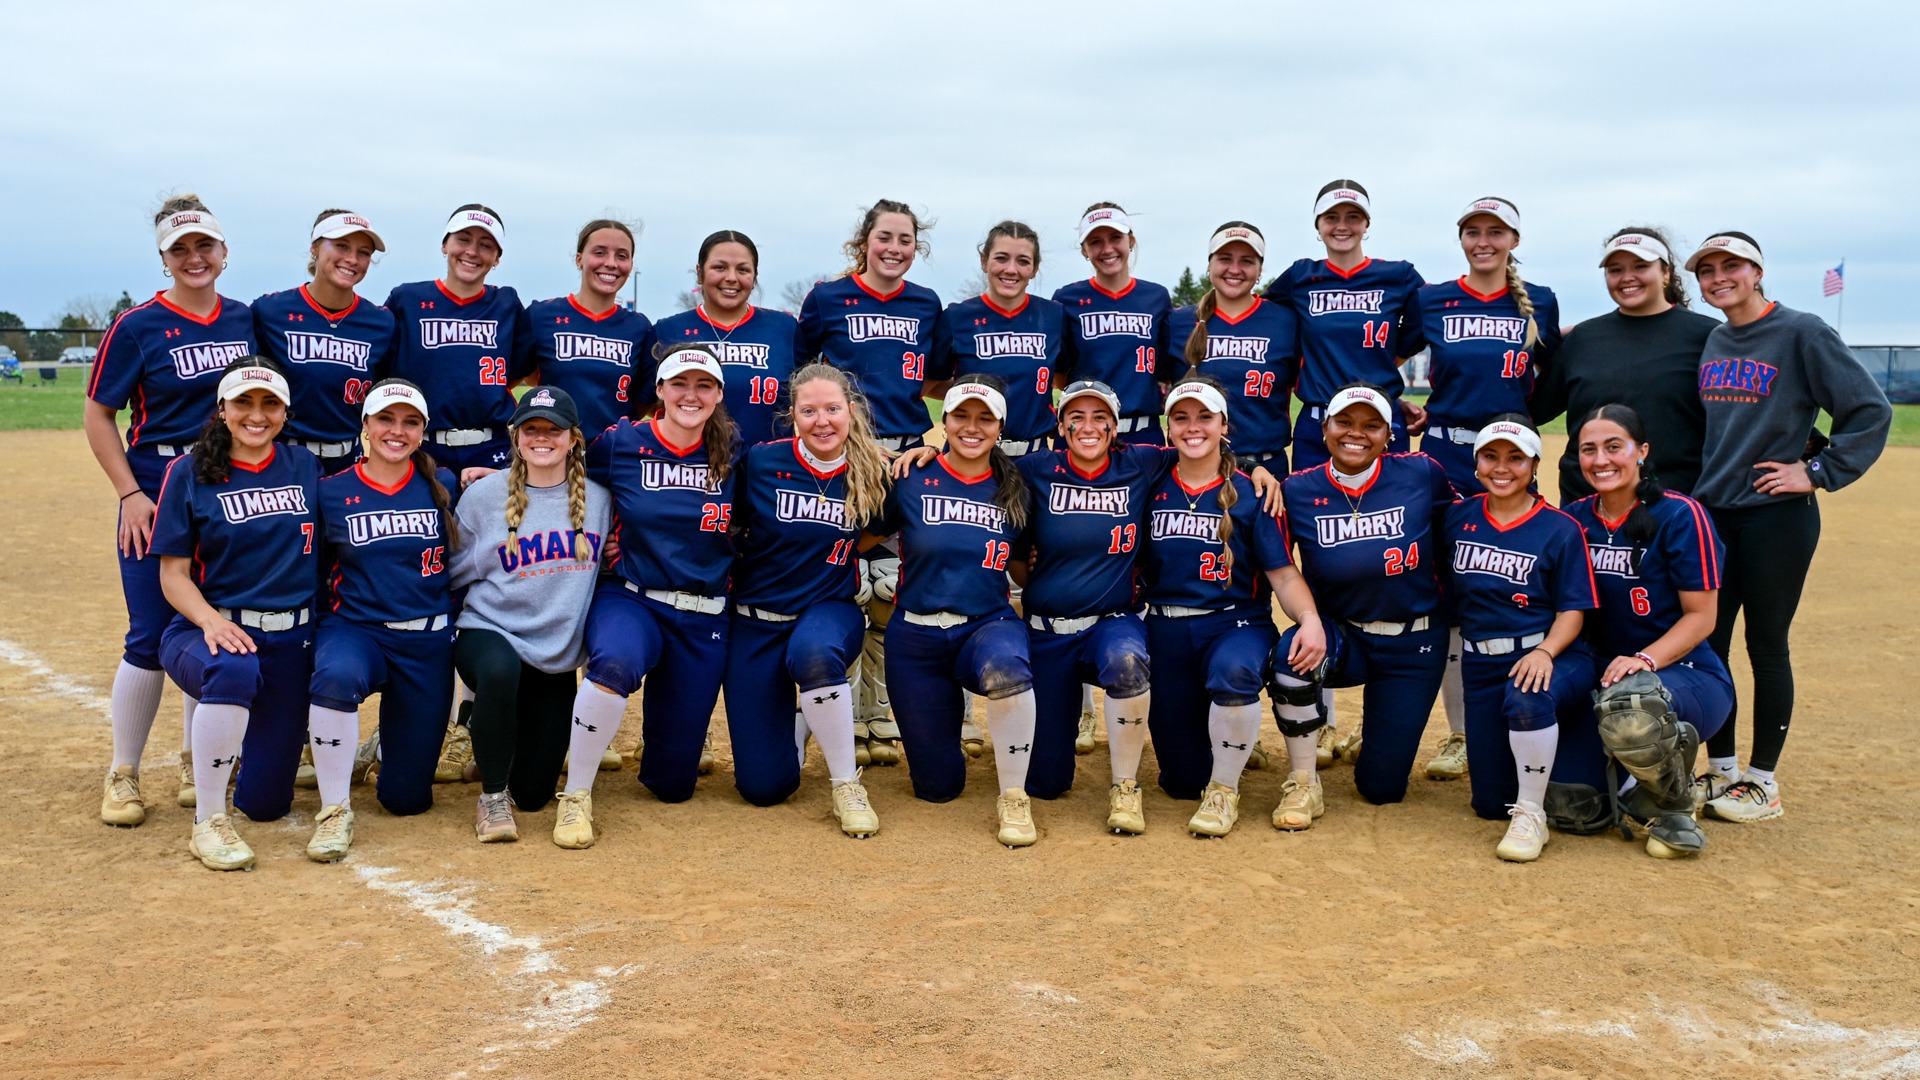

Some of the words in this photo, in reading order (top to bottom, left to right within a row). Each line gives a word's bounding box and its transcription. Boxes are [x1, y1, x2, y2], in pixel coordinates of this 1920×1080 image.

[1334, 191, 1358, 201] UMARY
[1473, 201, 1500, 211] UMARY
[171, 214, 201, 227] UMARY
[343, 216, 370, 229] UMARY
[467, 212, 494, 226] UMARY
[1088, 210, 1112, 223] UMARY
[1225, 230, 1250, 239] UMARY
[1615, 236, 1642, 246] UMARY
[1311, 291, 1383, 315] UMARY
[421, 319, 497, 348] UMARY
[847, 315, 919, 343] UMARY
[1080, 312, 1152, 338] UMARY
[1362, 320, 1389, 348] 14
[1444, 316, 1525, 342] UMARY
[286, 332, 370, 370] UMARY
[556, 333, 631, 366] UMARY
[706, 343, 767, 367] MARY
[975, 332, 1046, 358] UMARY
[479, 356, 506, 385] 22
[679, 353, 708, 366] UMARY
[902, 352, 924, 381] 21
[1135, 346, 1156, 373] 19
[1501, 350, 1529, 378] 16
[242, 369, 272, 382] UMARY
[616, 374, 631, 402] 9
[1036, 367, 1050, 394] 8
[1176, 384, 1203, 395] UMARY
[1244, 370, 1275, 398] 26
[383, 386, 413, 398] UMARY
[530, 397, 556, 407] UMARY
[750, 375, 779, 405] 18
[961, 386, 989, 397] UMARY
[1347, 390, 1375, 401] UMARY
[1492, 424, 1521, 435] UMARY
[218, 486, 308, 523] UMARY
[1050, 483, 1129, 515] UMARY
[346, 510, 439, 545] UMARY
[700, 503, 731, 532] 25
[922, 496, 1004, 532] UMARY
[1152, 511, 1221, 542] UMARY
[1316, 507, 1404, 546] UMARY
[301, 523, 314, 554] 7
[826, 539, 854, 565] 11
[1108, 523, 1136, 554] 13
[421, 546, 445, 577] 15
[982, 540, 1010, 571] 12
[1200, 552, 1229, 580] 23
[1384, 542, 1419, 576] 24
[1454, 541, 1536, 584] UMARY
[519, 564, 593, 578] MARAUDERS
[1630, 587, 1651, 616] 6
